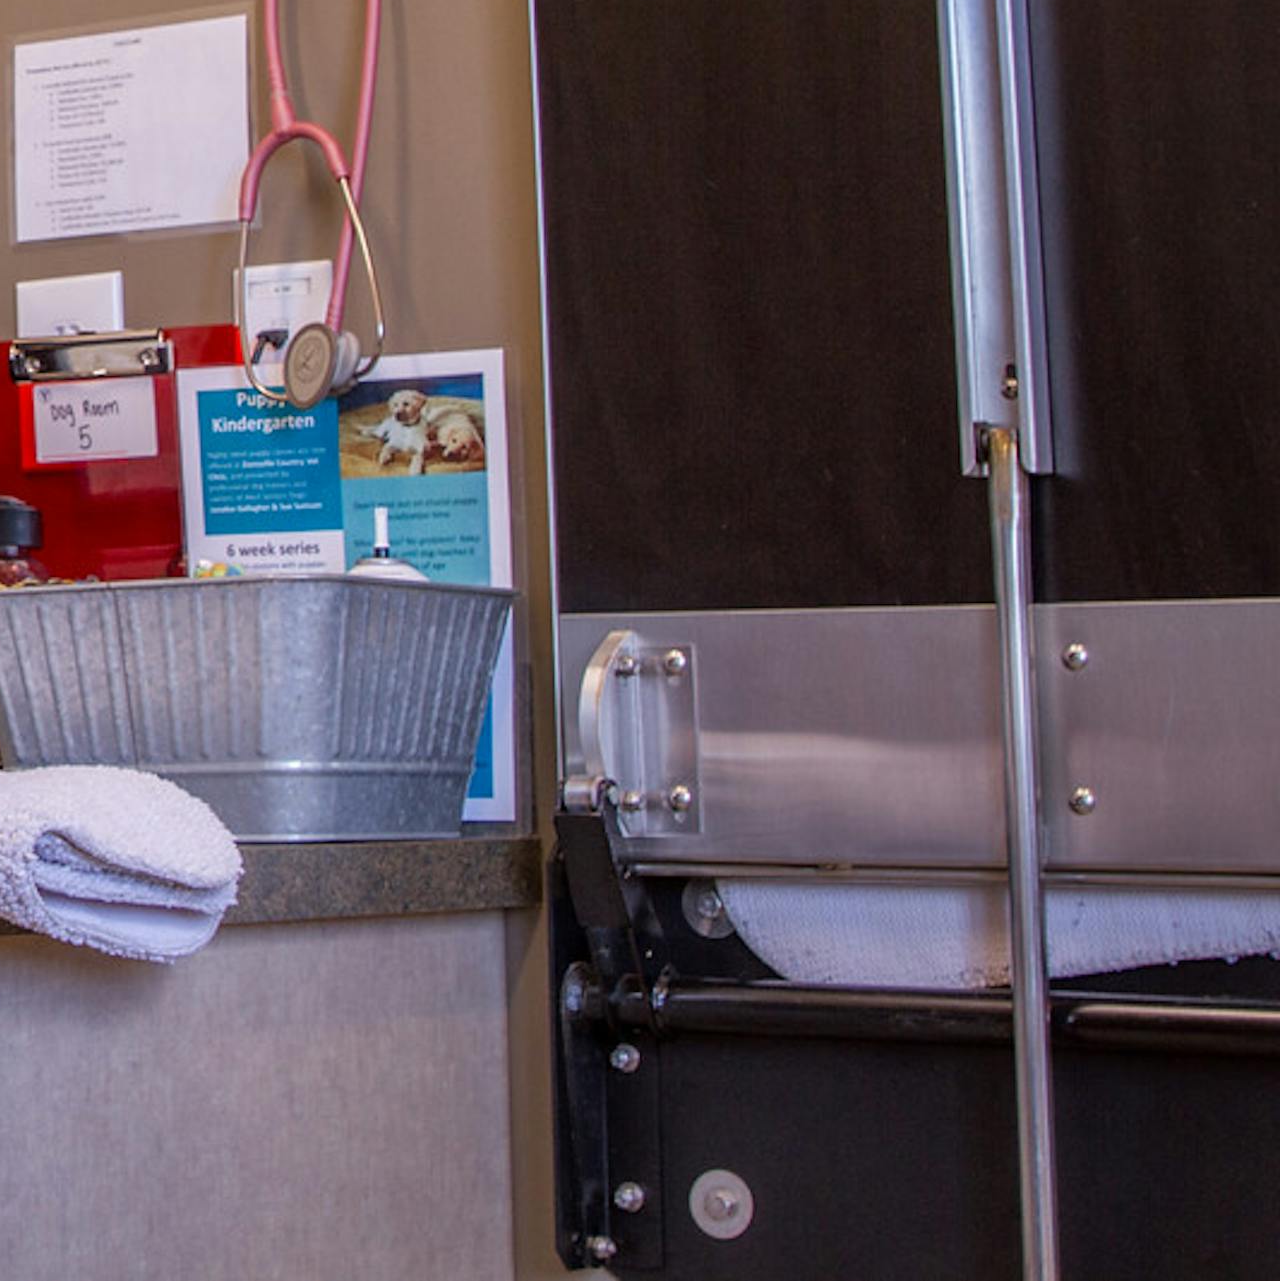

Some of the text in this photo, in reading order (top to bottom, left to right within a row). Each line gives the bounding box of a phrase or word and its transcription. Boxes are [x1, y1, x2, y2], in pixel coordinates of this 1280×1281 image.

[82, 400, 120, 417] Room
[236, 392, 285, 409] Pup
[211, 415, 316, 434] Kindergarten
[78, 424, 93, 450] 5
[226, 540, 321, 556] 6 week series
